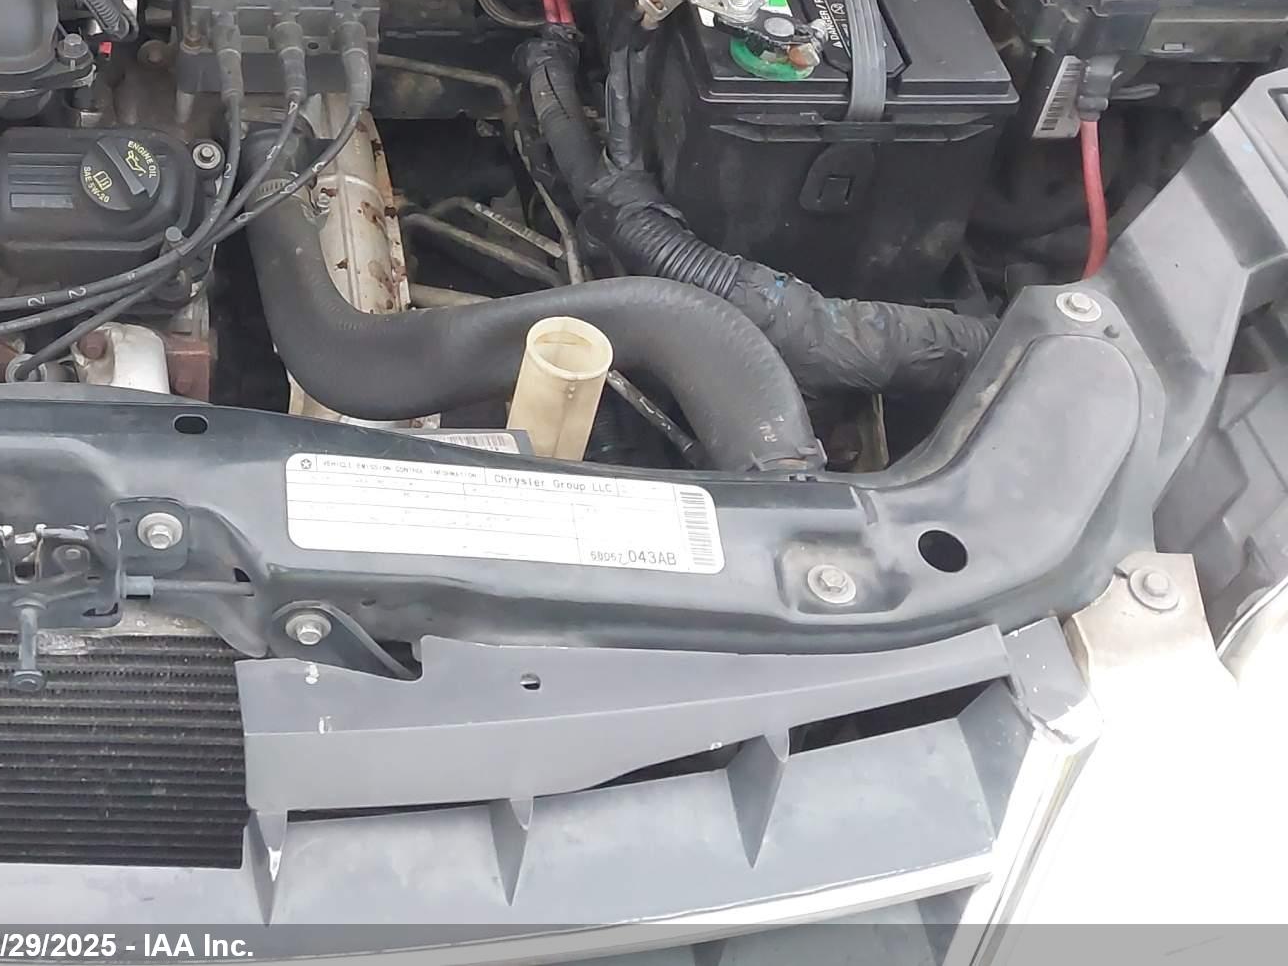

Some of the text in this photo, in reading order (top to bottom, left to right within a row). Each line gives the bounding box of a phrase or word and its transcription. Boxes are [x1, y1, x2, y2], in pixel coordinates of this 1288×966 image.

[820, 10, 840, 41] DANGER
[127, 140, 157, 179] ENGINE OIL
[83, 166, 110, 203] SAE 5W-20
[494, 474, 612, 493] Chrysler Group LLC
